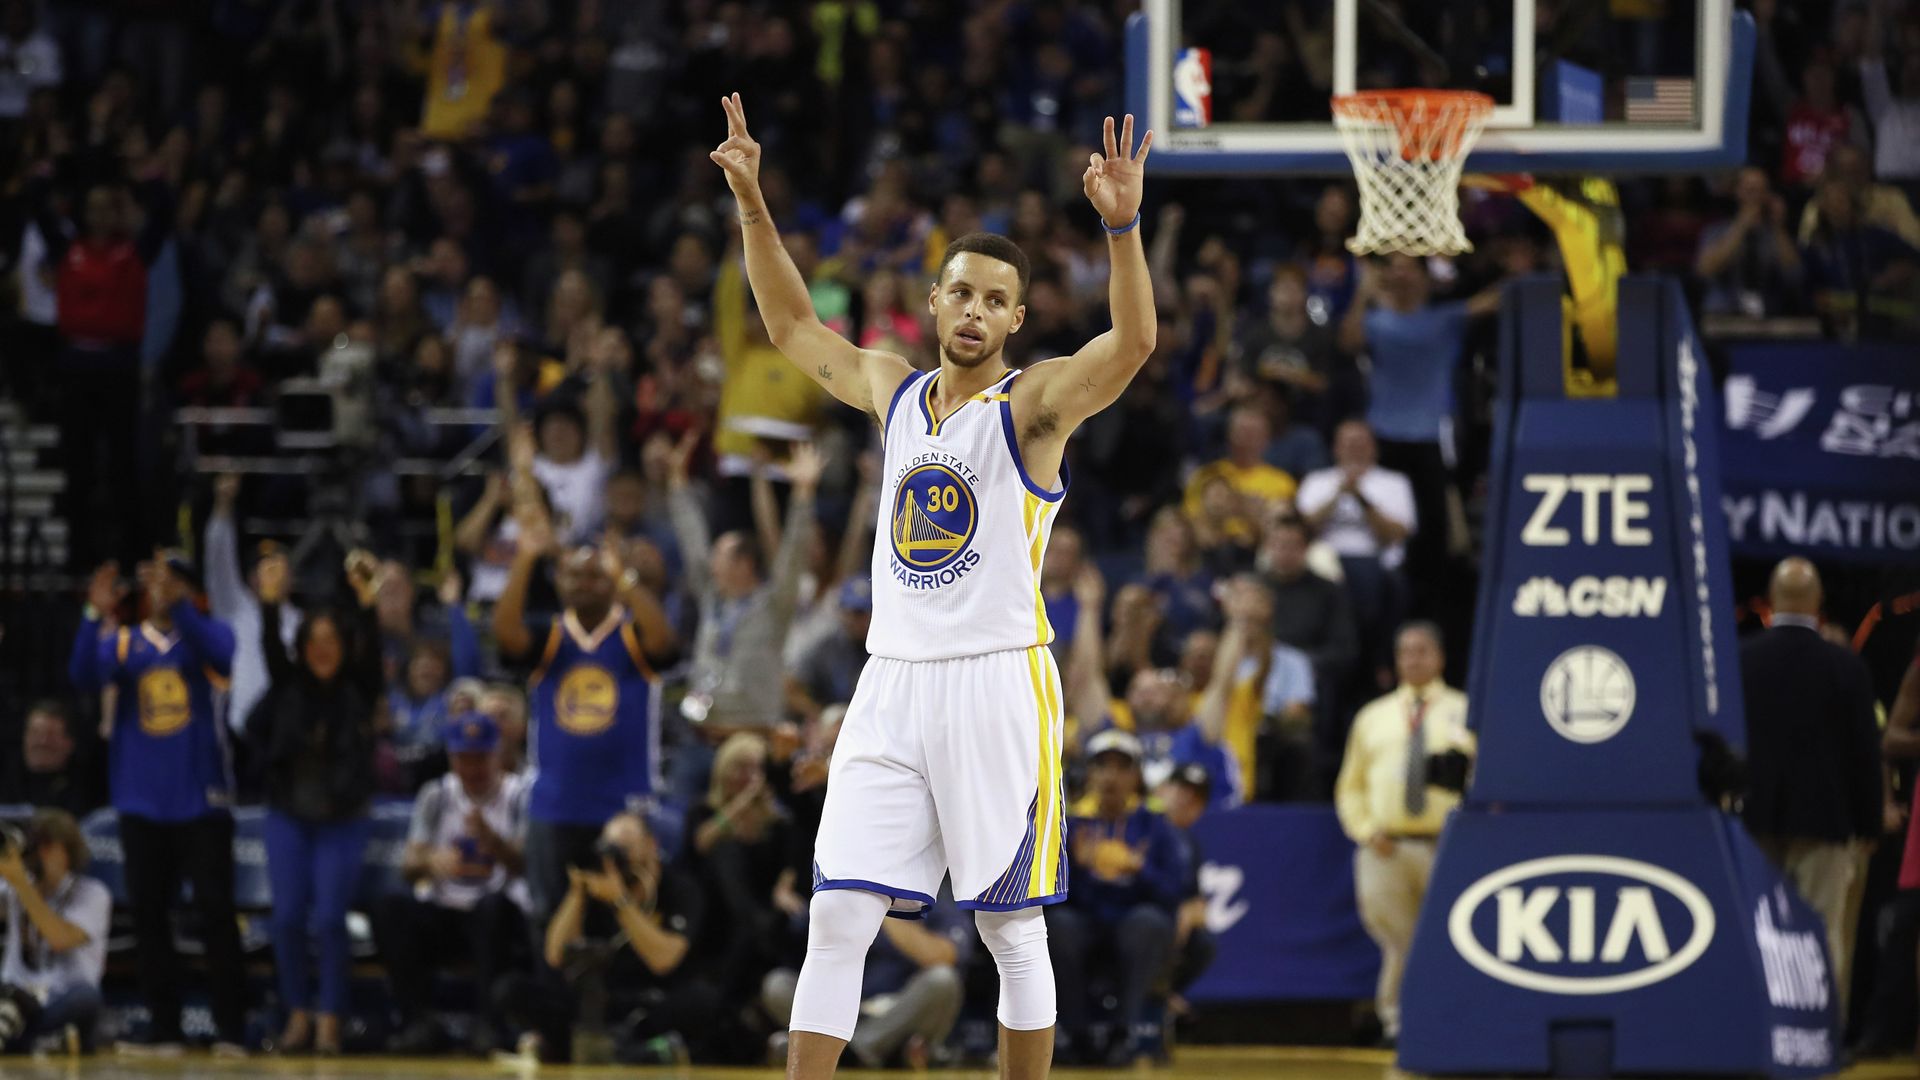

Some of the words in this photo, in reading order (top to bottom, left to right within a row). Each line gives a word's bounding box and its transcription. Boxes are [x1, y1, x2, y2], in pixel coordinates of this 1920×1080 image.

[893, 452, 939, 488] GOLDEN
[940, 453, 980, 486] STATE
[927, 485, 959, 513] 30
[1521, 474, 1653, 546] ZTE
[889, 549, 981, 590] WARRIORS
[1568, 576, 1667, 617] CSN
[1495, 886, 1671, 963] KIA
